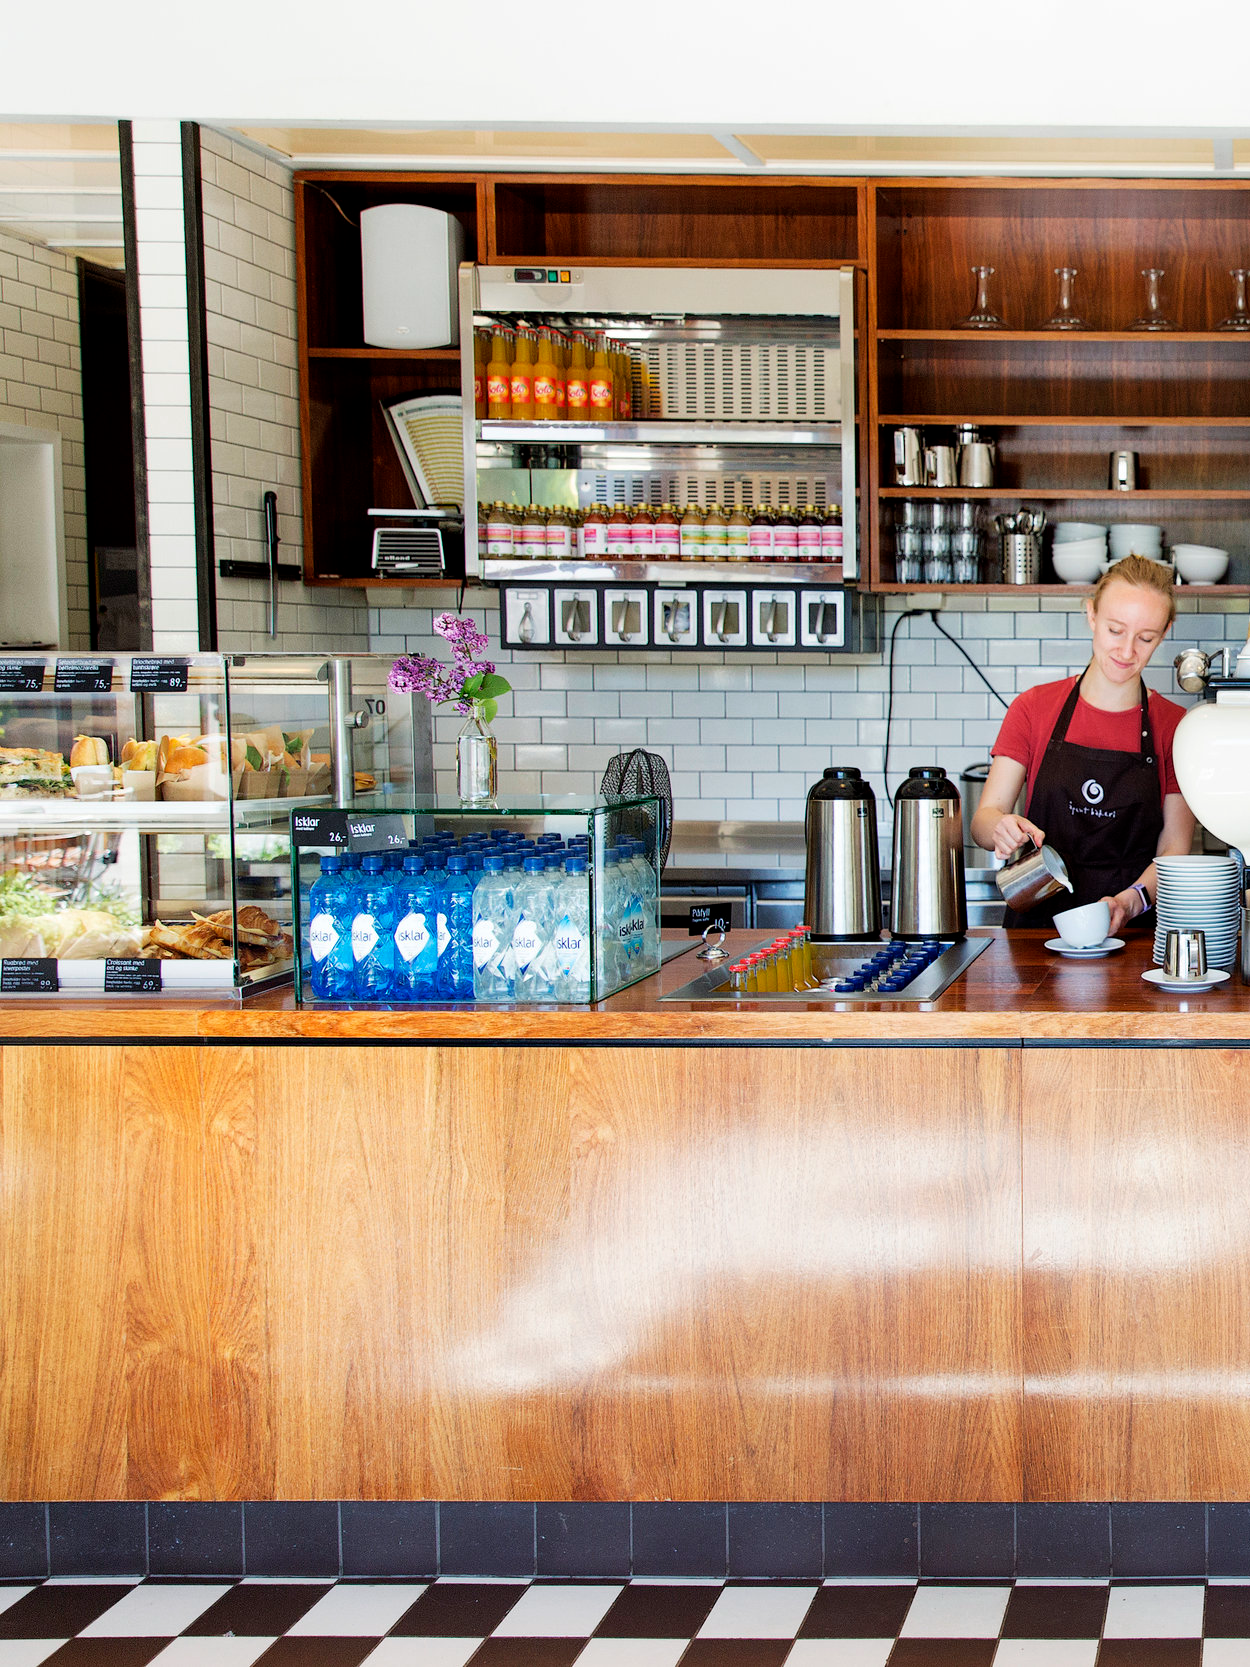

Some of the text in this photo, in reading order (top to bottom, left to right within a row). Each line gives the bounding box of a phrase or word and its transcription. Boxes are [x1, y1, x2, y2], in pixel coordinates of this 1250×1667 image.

[26, 679, 42, 689] 75,-
[94, 679, 110, 689] 75,-
[169, 677, 186, 688] 89,-
[295, 816, 320, 827] Isklar
[350, 823, 376, 834] Isklar
[329, 832, 347, 843] 26,-
[387, 835, 406, 845] 26,-
[714, 918, 730, 930] 10,-
[142, 980, 159, 990] 69,-
